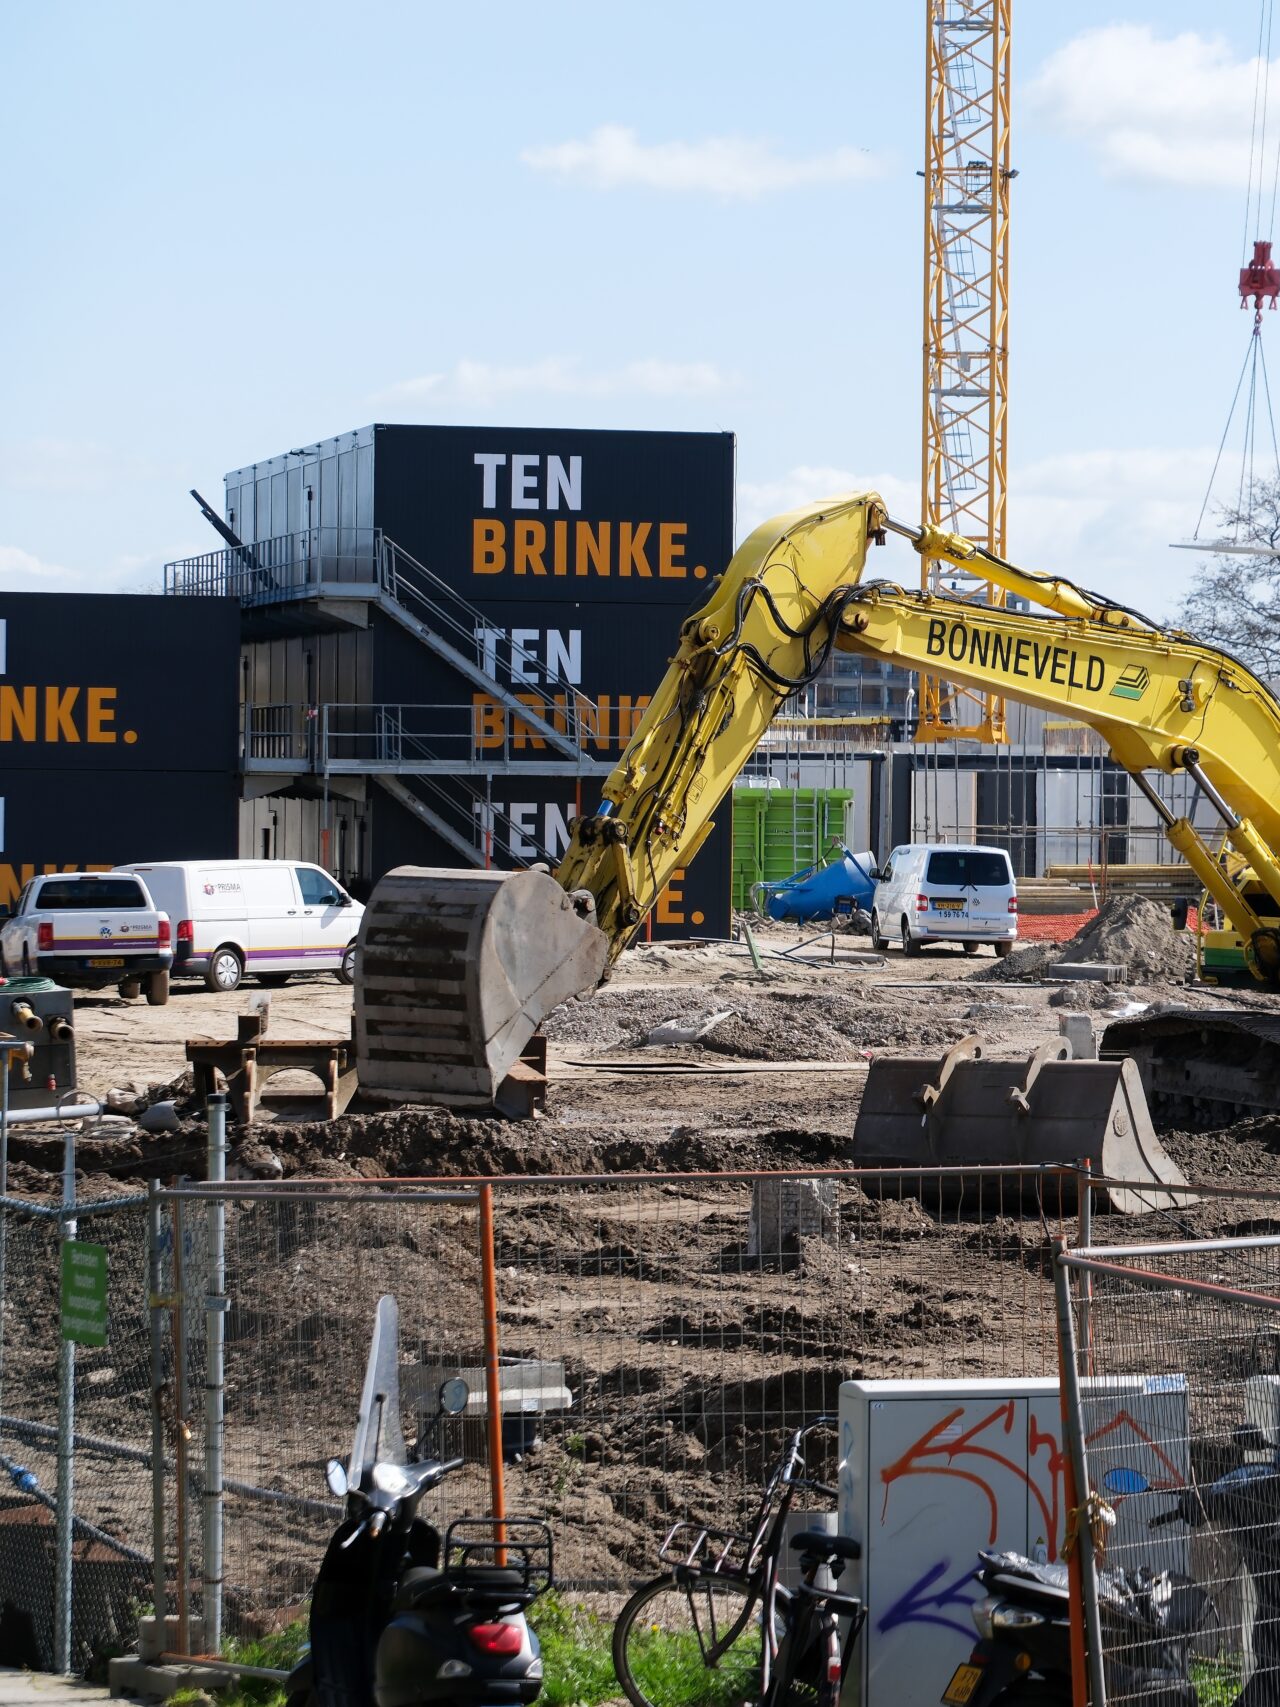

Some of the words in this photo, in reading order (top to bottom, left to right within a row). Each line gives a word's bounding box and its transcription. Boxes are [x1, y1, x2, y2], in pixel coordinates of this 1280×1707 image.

[474, 453, 582, 511] TEN
[473, 519, 707, 578] BRINKE.
[474, 628, 582, 685] TEN
[927, 618, 1105, 692] BONNEVELD
[0, 686, 138, 743] NKE.
